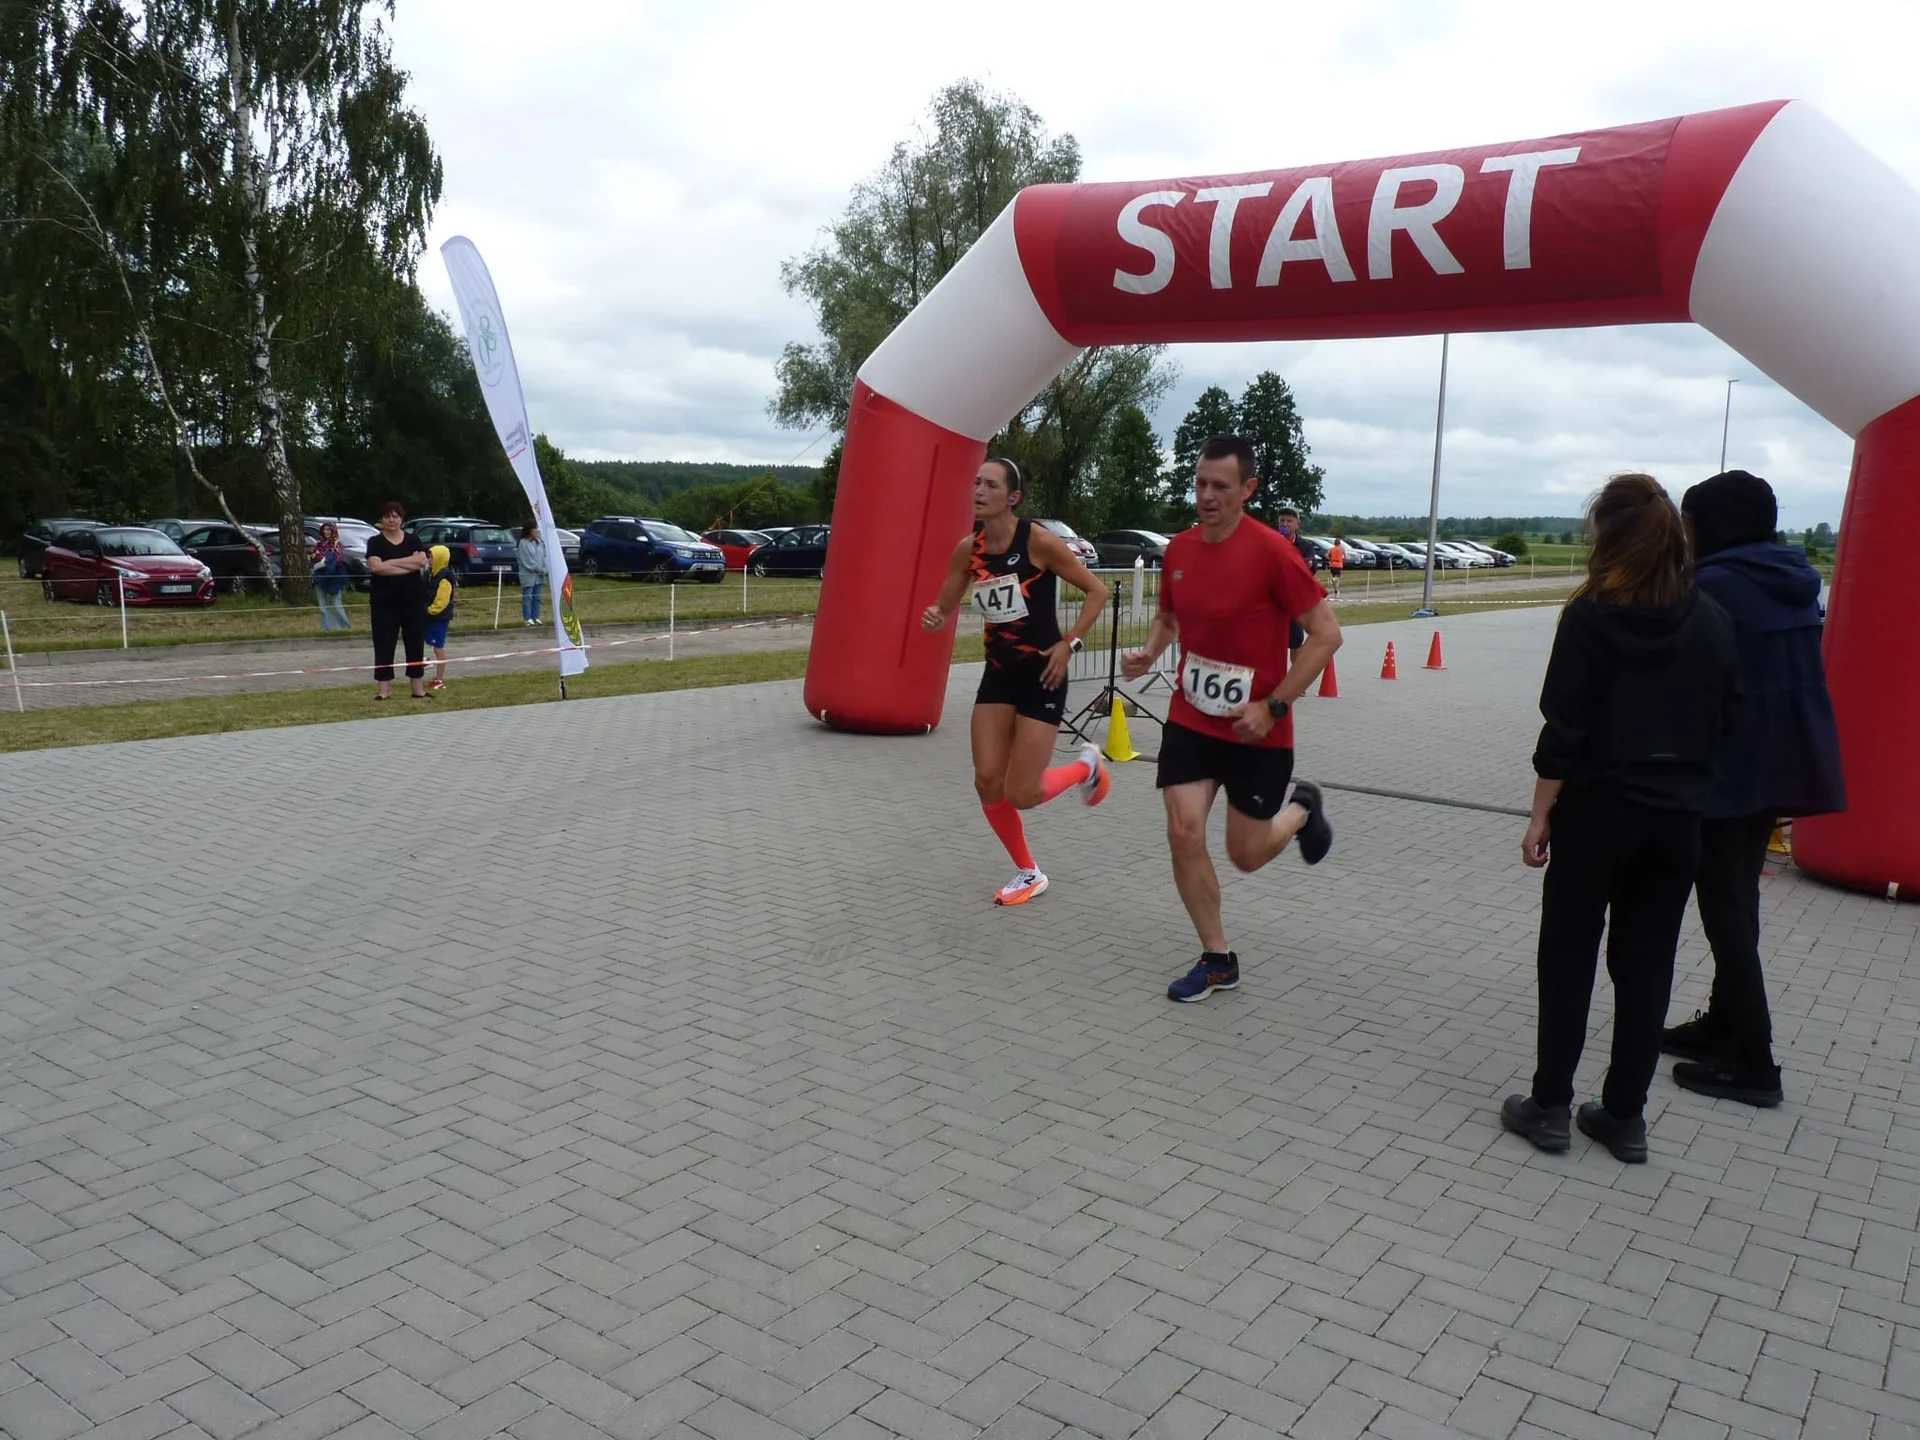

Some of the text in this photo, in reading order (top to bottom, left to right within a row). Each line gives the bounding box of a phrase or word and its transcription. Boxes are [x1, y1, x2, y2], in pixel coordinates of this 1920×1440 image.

[1113, 147, 1581, 295] START
[974, 584, 1014, 612] 147
[1190, 667, 1243, 704] 166
